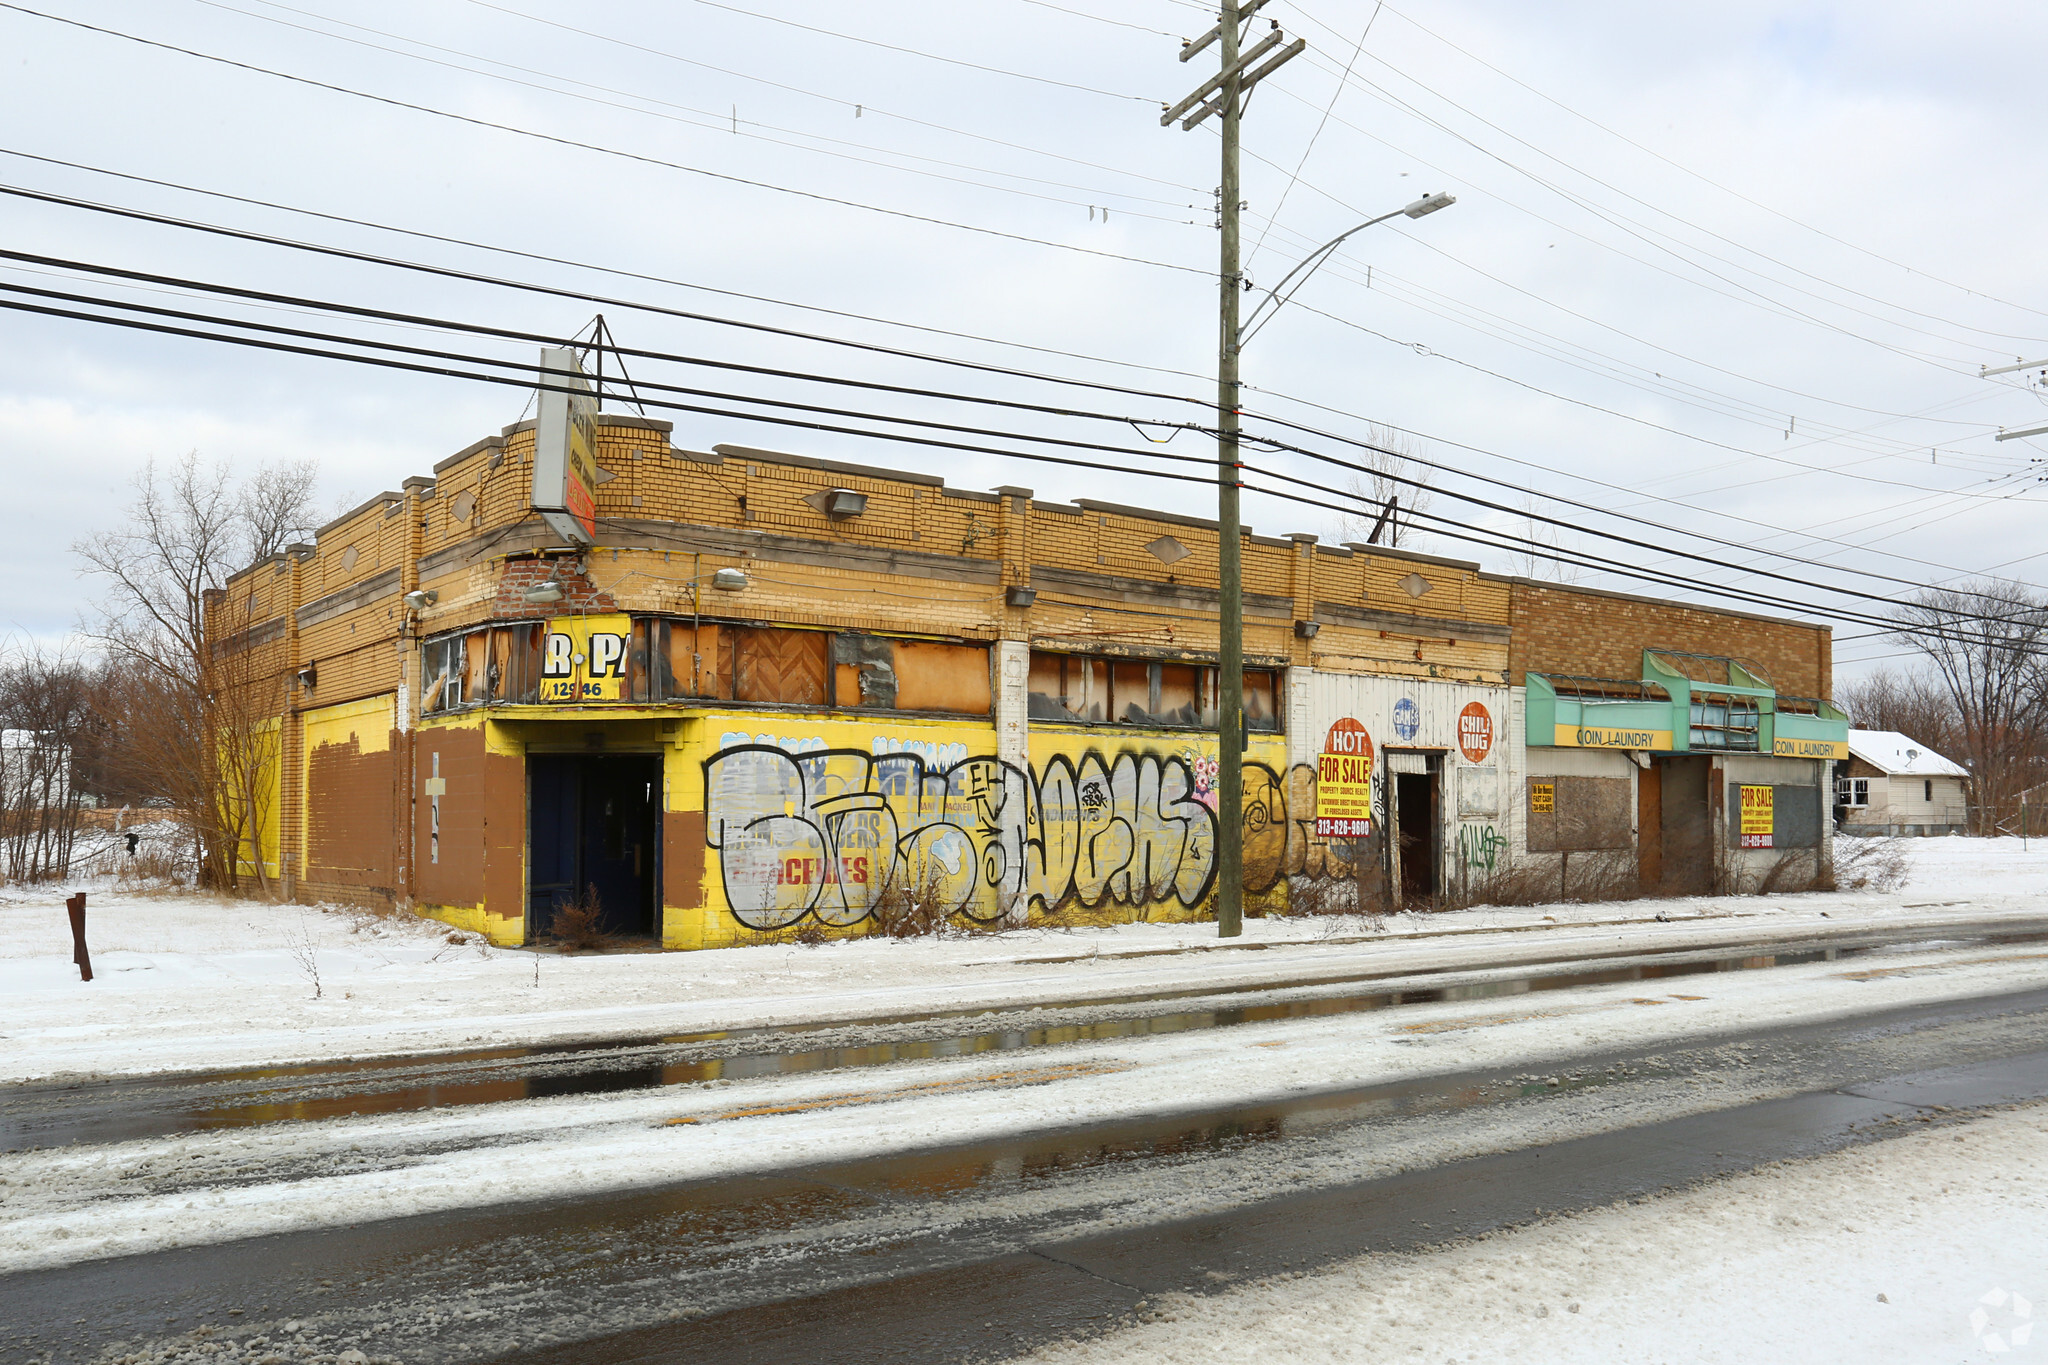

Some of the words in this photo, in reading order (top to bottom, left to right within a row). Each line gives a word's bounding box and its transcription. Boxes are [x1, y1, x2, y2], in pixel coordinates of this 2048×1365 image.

[1333, 730, 1366, 753] HOT
[1576, 729, 1602, 745] COIN
[1608, 731, 1655, 747] LAUNDRY
[1774, 741, 1795, 754] COIN
[1799, 743, 1835, 757] LAUNDRY
[1318, 757, 1339, 782] FOR
[1342, 758, 1369, 784] SALE
[1741, 788, 1754, 807] FOR
[1756, 788, 1773, 808] SALE
[1317, 819, 1370, 836] 313-626-9600
